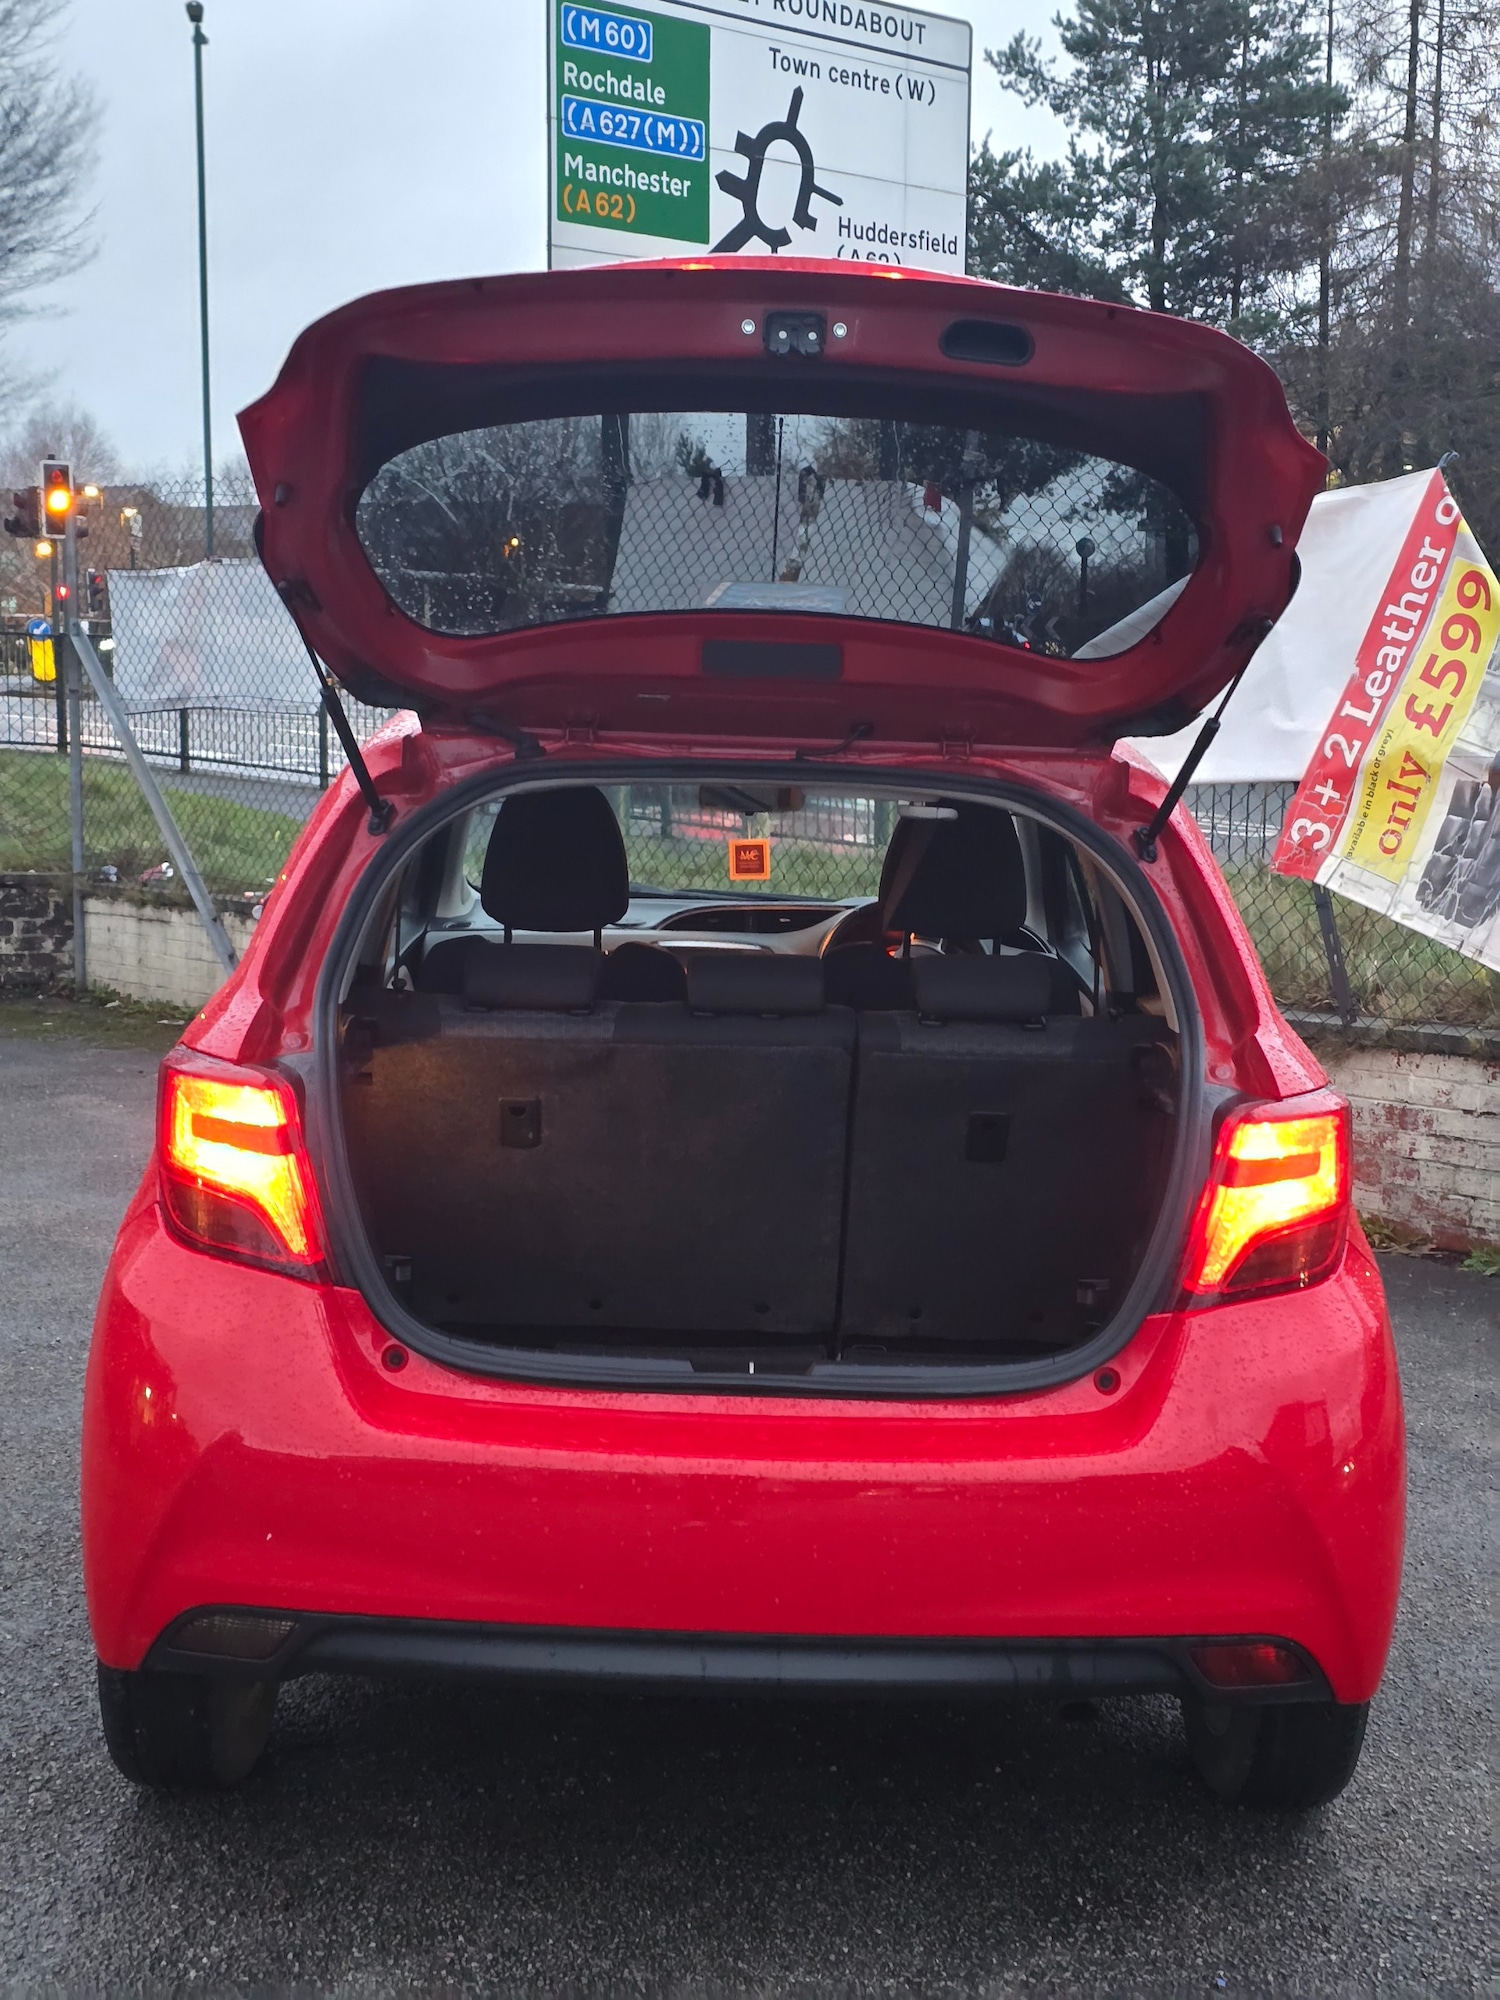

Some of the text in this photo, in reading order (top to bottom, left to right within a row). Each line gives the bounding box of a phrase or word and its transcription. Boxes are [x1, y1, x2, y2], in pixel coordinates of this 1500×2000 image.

[563, 61, 666, 105] Rochdale
[769, 46, 936, 106] Town centre (W)
[564, 152, 691, 197] Manchester
[838, 215, 958, 255] Huddersfield
[1340, 535, 1446, 728] Leather
[1378, 570, 1491, 855] only £599
[1323, 733, 1362, 768] 2
[1378, 729, 1394, 756] grey)
[1374, 757, 1381, 768] or
[1366, 771, 1379, 798] black
[1363, 800, 1373, 810] in
[1290, 818, 1331, 850] 3
